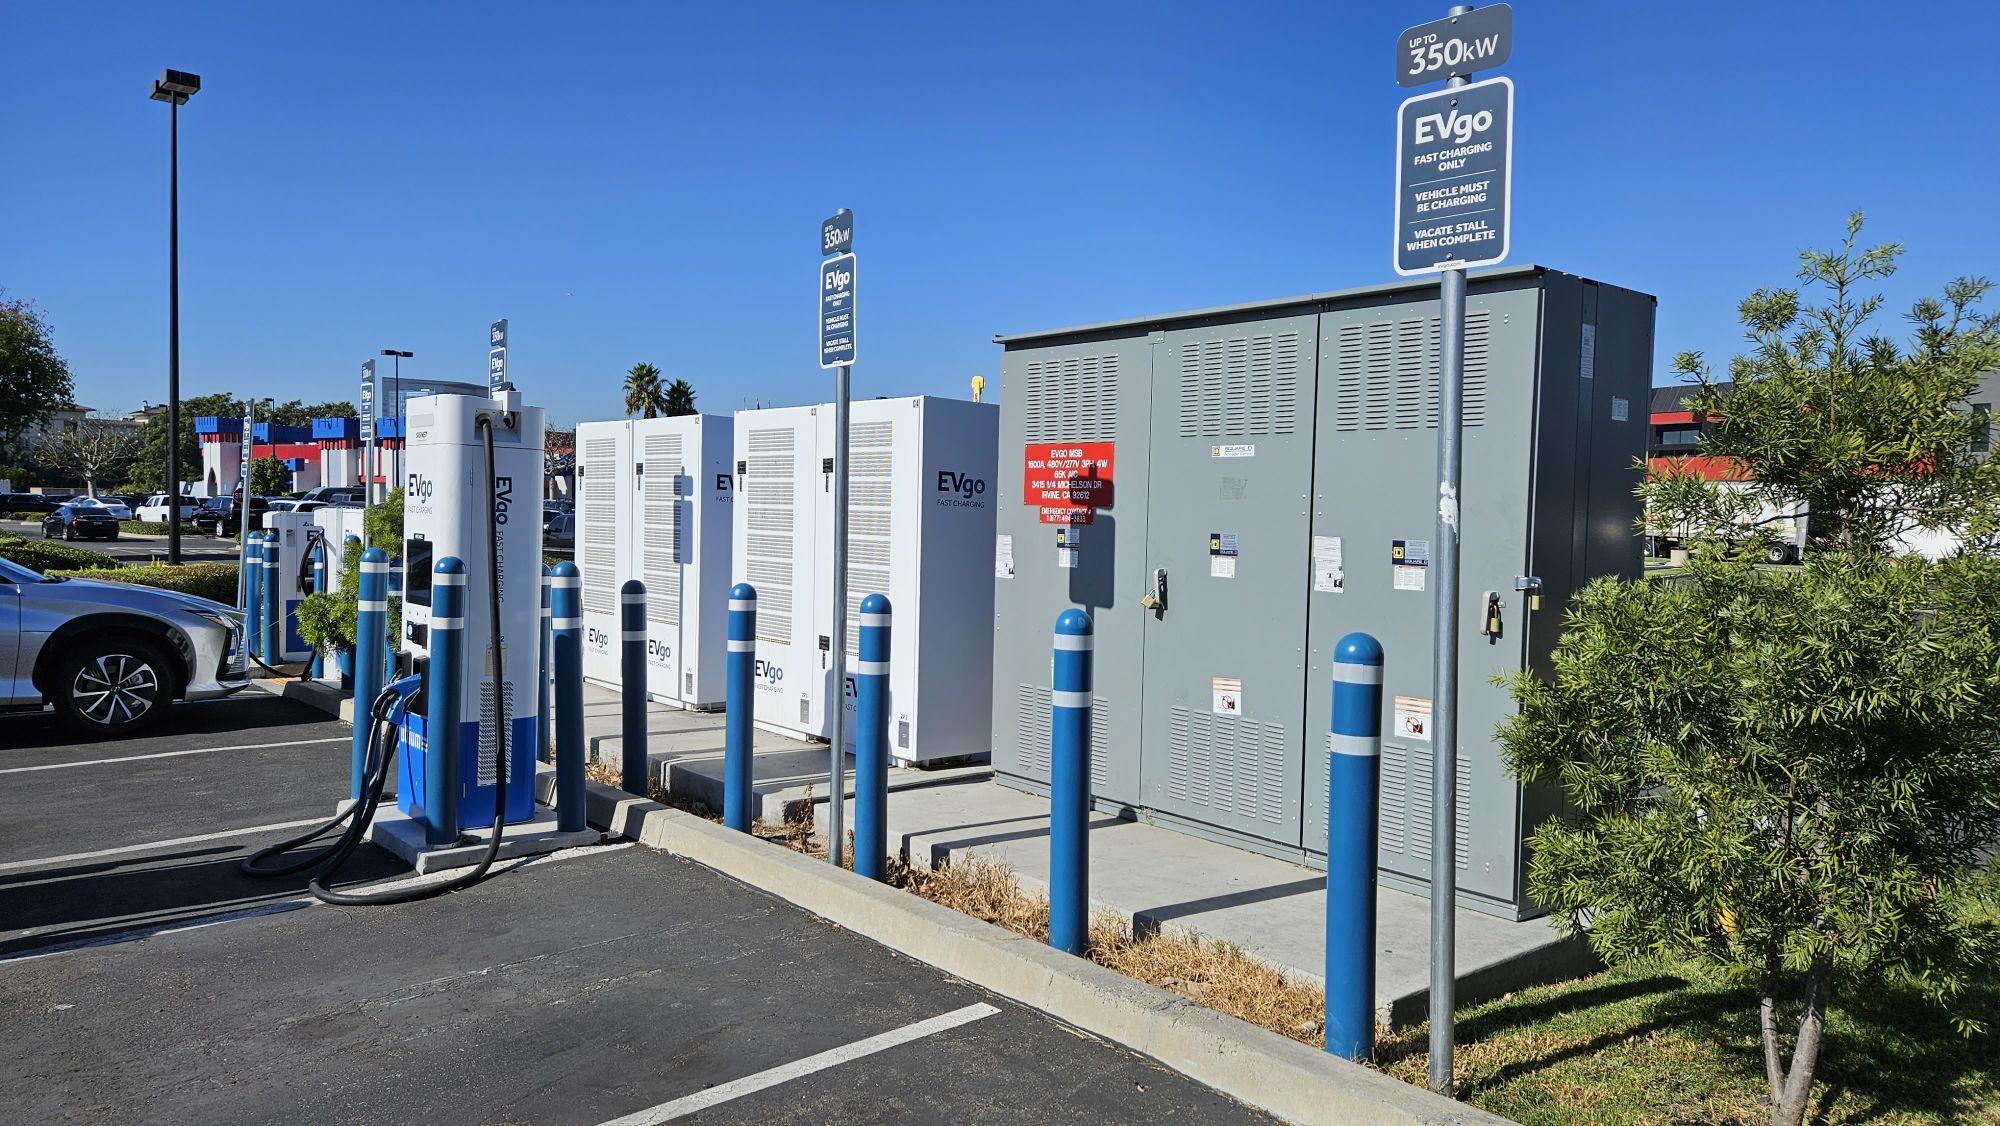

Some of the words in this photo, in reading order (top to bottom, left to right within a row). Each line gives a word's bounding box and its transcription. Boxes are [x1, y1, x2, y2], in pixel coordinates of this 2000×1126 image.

[1409, 36, 1422, 48] UP
[1422, 33, 1437, 45] TO
[1409, 34, 1499, 75] 350kW
[1415, 109, 1493, 144] EVgo
[1414, 152, 1438, 166] FAST
[1439, 141, 1493, 161] CHARGING
[1438, 158, 1466, 172] ONLY
[1415, 185, 1458, 202] VEHICLE
[1459, 180, 1490, 195] MUST
[1416, 202, 1430, 213] BE
[1431, 192, 1487, 211] CHARGING
[825, 228, 850, 249] 350kW
[1406, 238, 1438, 252] WHEN
[1439, 229, 1496, 247] COMPLETE
[1414, 225, 1453, 240] VACATE
[1455, 220, 1488, 234] STALL
[826, 270, 850, 290] EVgo
[409, 474, 433, 504] EVgo
[938, 471, 985, 499] EVgo
[1093, 481, 1102, 489] DR
[496, 476, 513, 525] EVgo
[936, 499, 952, 507] FAST
[953, 500, 985, 508] CHARGING
[589, 628, 608, 648] EVgo
[649, 639, 671, 661] EVgo
[756, 660, 783, 684] EVgo
